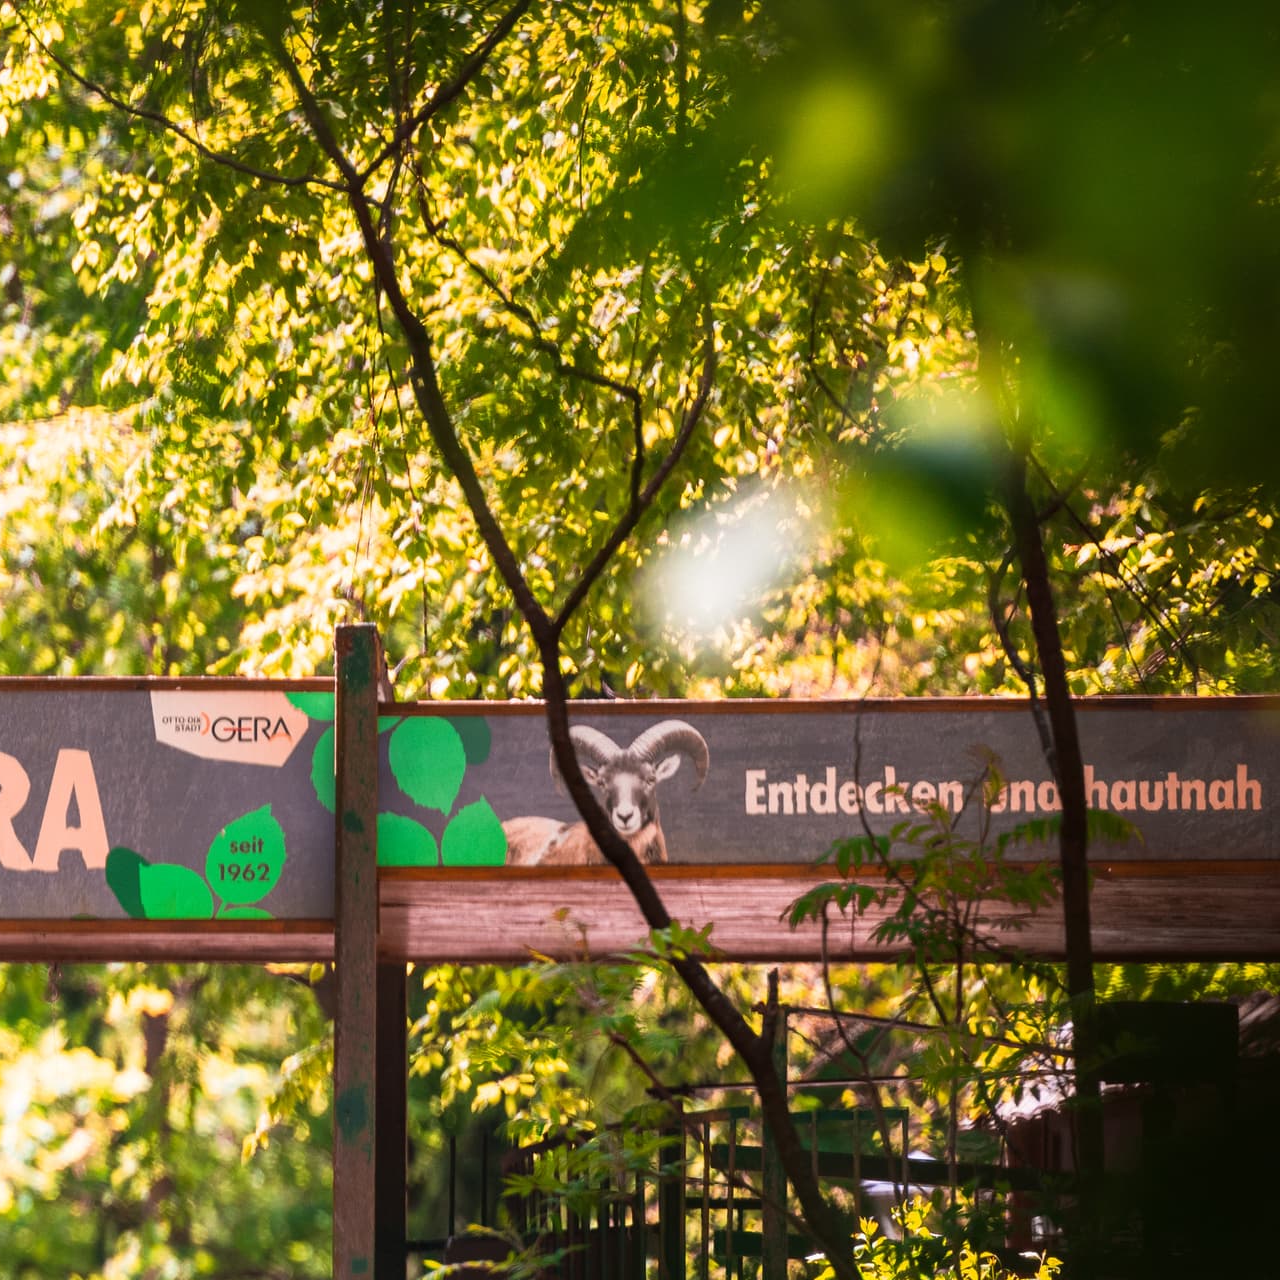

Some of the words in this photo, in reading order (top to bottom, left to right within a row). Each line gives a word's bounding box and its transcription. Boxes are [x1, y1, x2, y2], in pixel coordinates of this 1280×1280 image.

[174, 724, 201, 733] STADT
[211, 716, 292, 742] GERA
[744, 765, 964, 816] Entdecken
[1083, 764, 1263, 811] hautnah
[229, 836, 265, 854] seit
[217, 863, 271, 882] 1962
